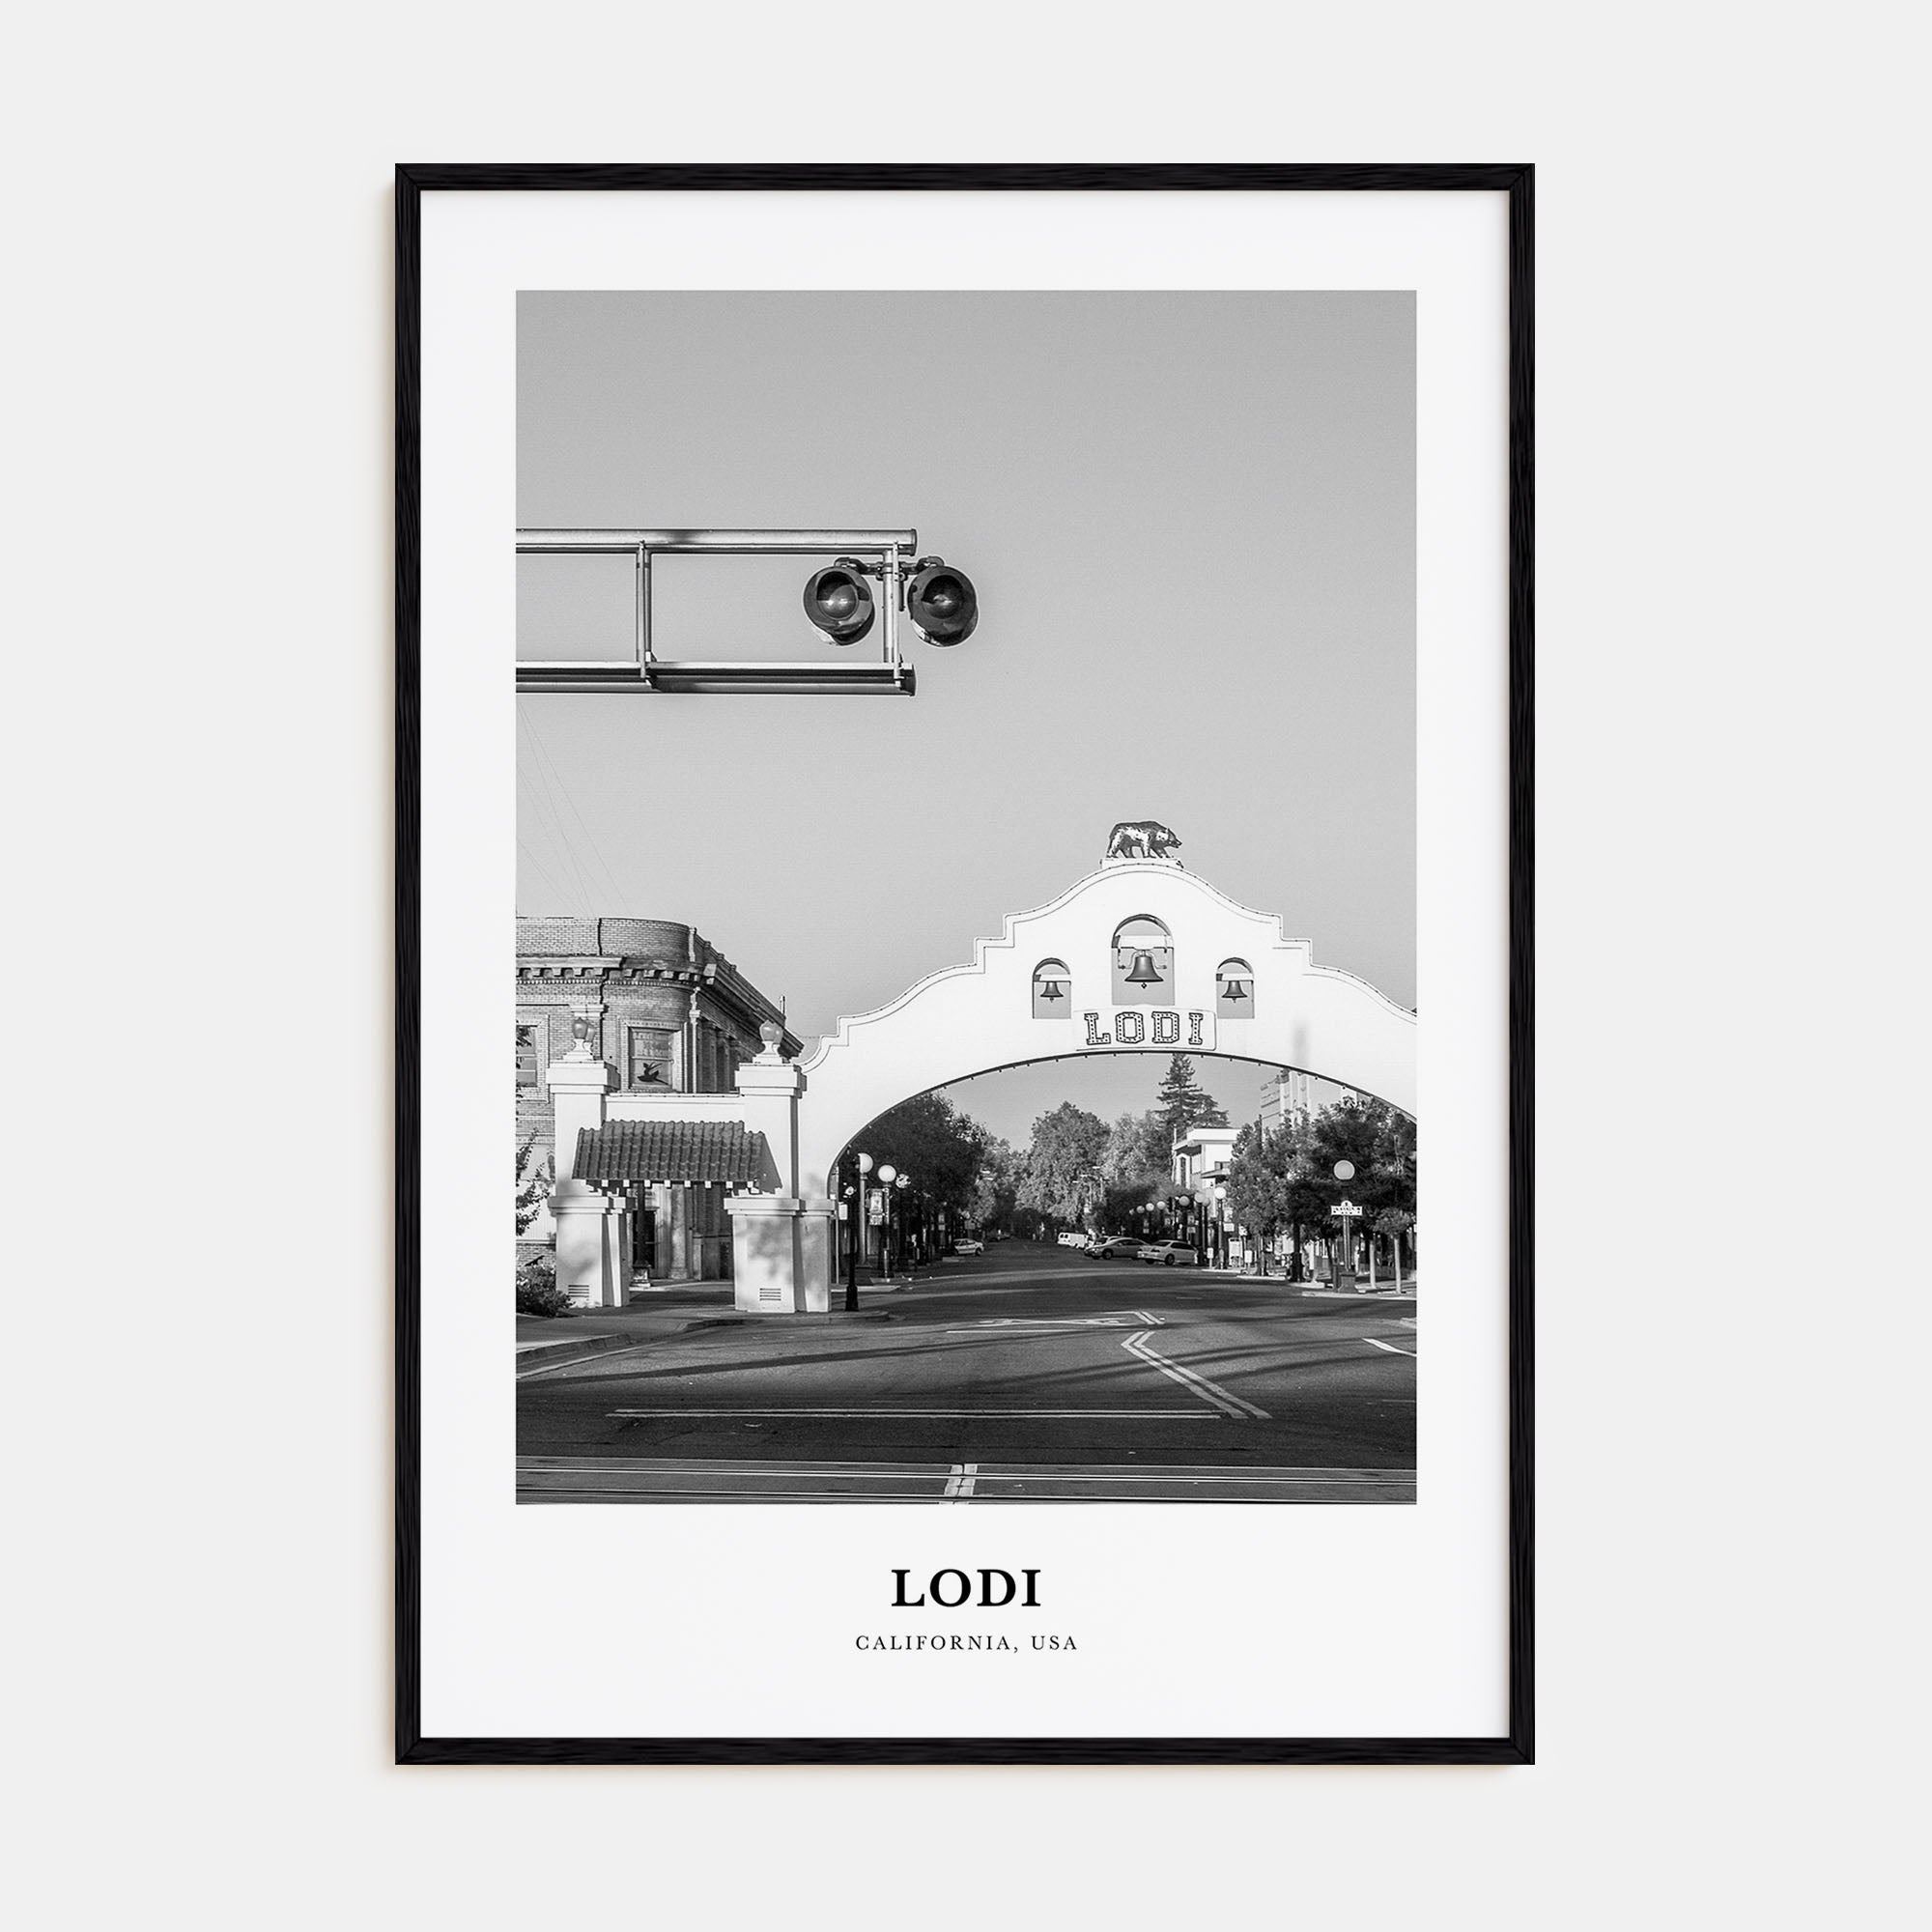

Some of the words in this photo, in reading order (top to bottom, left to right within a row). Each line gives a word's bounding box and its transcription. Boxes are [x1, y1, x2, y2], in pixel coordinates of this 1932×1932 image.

[1084, 1011, 1204, 1045] LODI
[891, 1568, 1041, 1607] LODI
[855, 1634, 1018, 1653] CALIFORNIA,
[1031, 1634, 1077, 1651] USA
